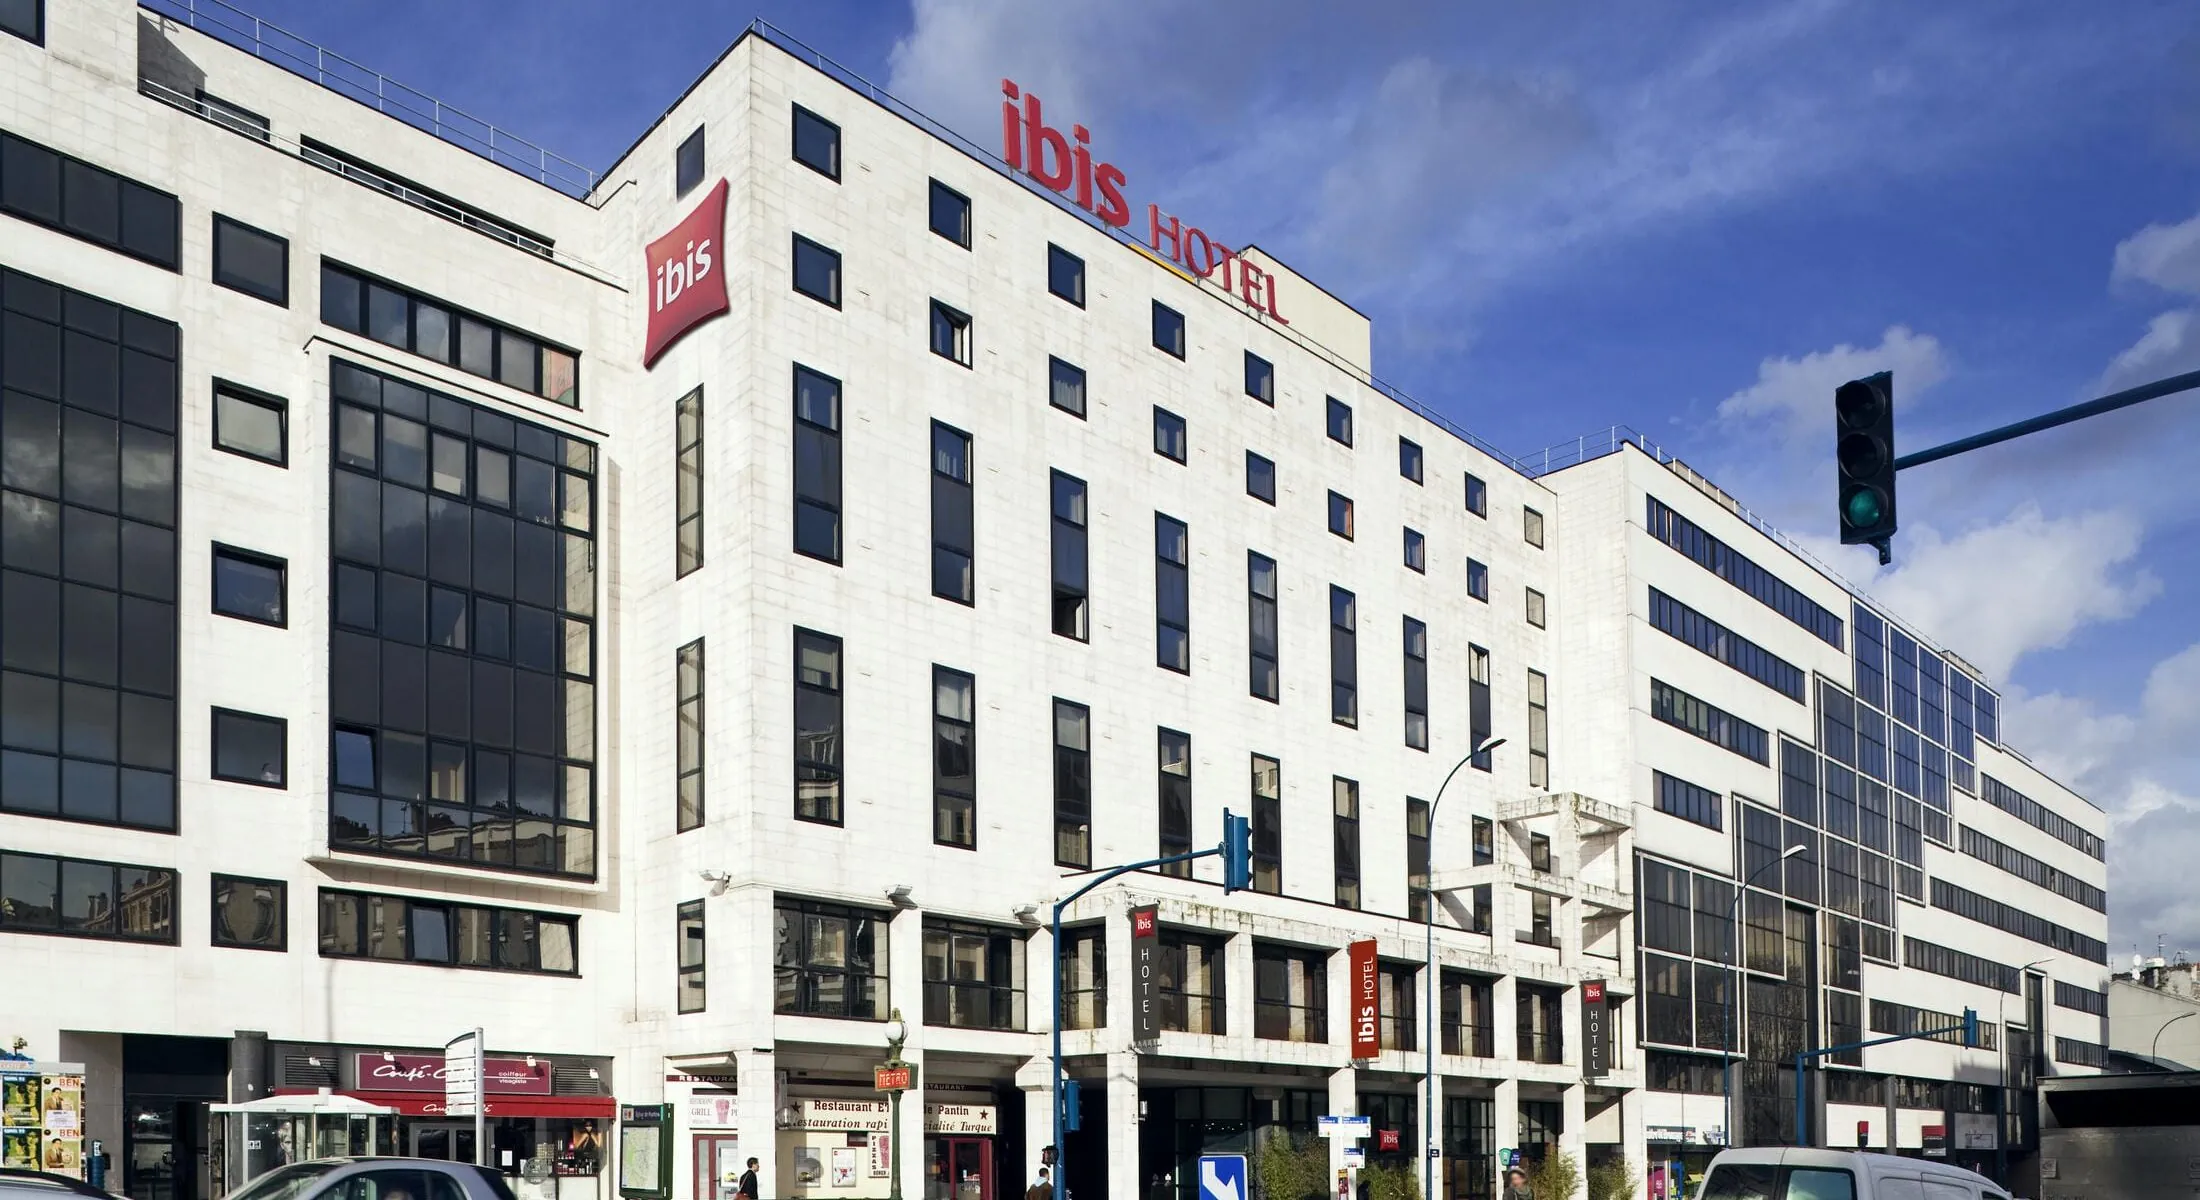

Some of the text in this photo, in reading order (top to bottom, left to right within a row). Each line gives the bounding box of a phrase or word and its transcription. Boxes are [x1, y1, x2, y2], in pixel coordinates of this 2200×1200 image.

[1001, 78, 1289, 325] ibis HOTEL
[656, 238, 712, 313] ibis
[1137, 918, 1152, 931] ibis
[1141, 948, 1150, 1031] HOTEL
[1587, 988, 1601, 997] ibis
[1358, 956, 1375, 1043] ibis HOTEL
[1590, 1010, 1599, 1070] HOTEL
[60, 1079, 80, 1087] BEN
[879, 1072, 908, 1086] METRO
[814, 1100, 872, 1112] Restaurant
[938, 1106, 969, 1116] Pantin
[60, 1129, 80, 1137] BEN
[793, 1117, 861, 1129] estauration
[866, 1118, 888, 1131] rapi
[960, 1121, 993, 1133] Turque
[1383, 1134, 1399, 1144] ibis
